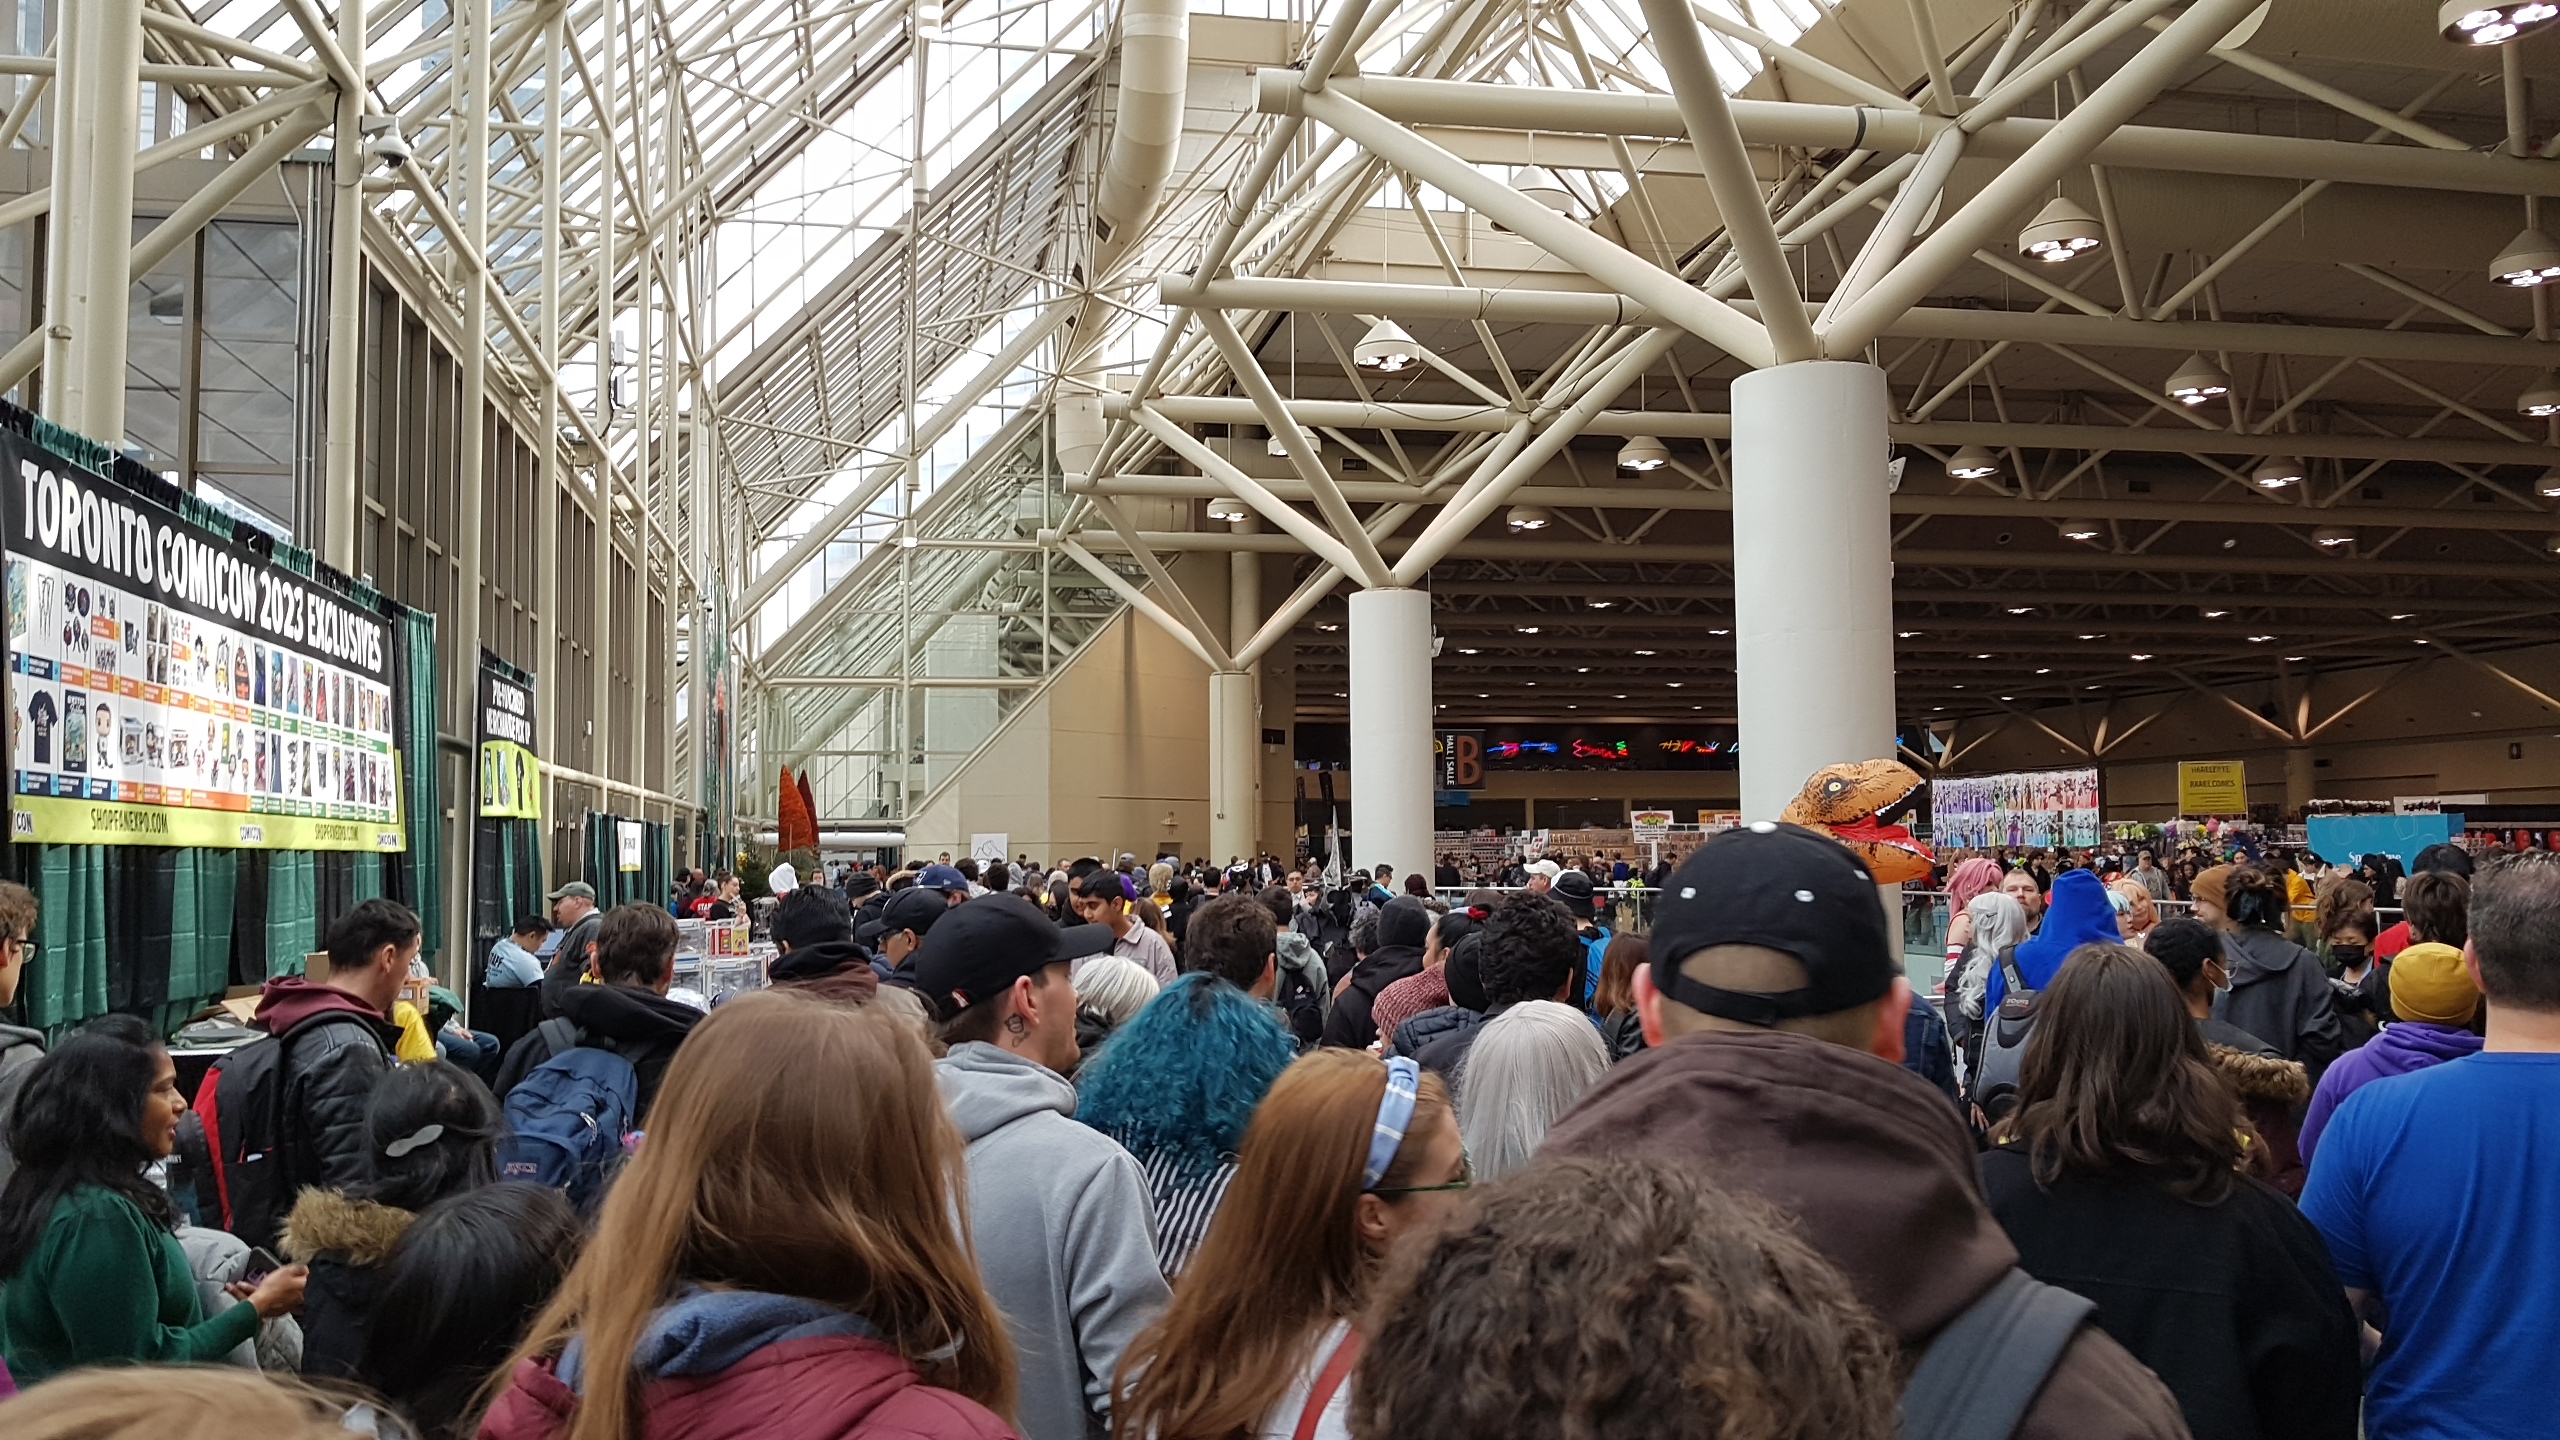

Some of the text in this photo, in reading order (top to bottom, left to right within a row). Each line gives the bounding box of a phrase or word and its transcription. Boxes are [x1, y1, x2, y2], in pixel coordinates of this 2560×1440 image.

[21, 459, 382, 674] TORONTO COMICON 2023 EXCLUSIVES
[1446, 735, 1455, 785] HALL SALLE
[1456, 735, 1483, 785] B
[90, 808, 169, 834] SHOPFANEXPO.COM
